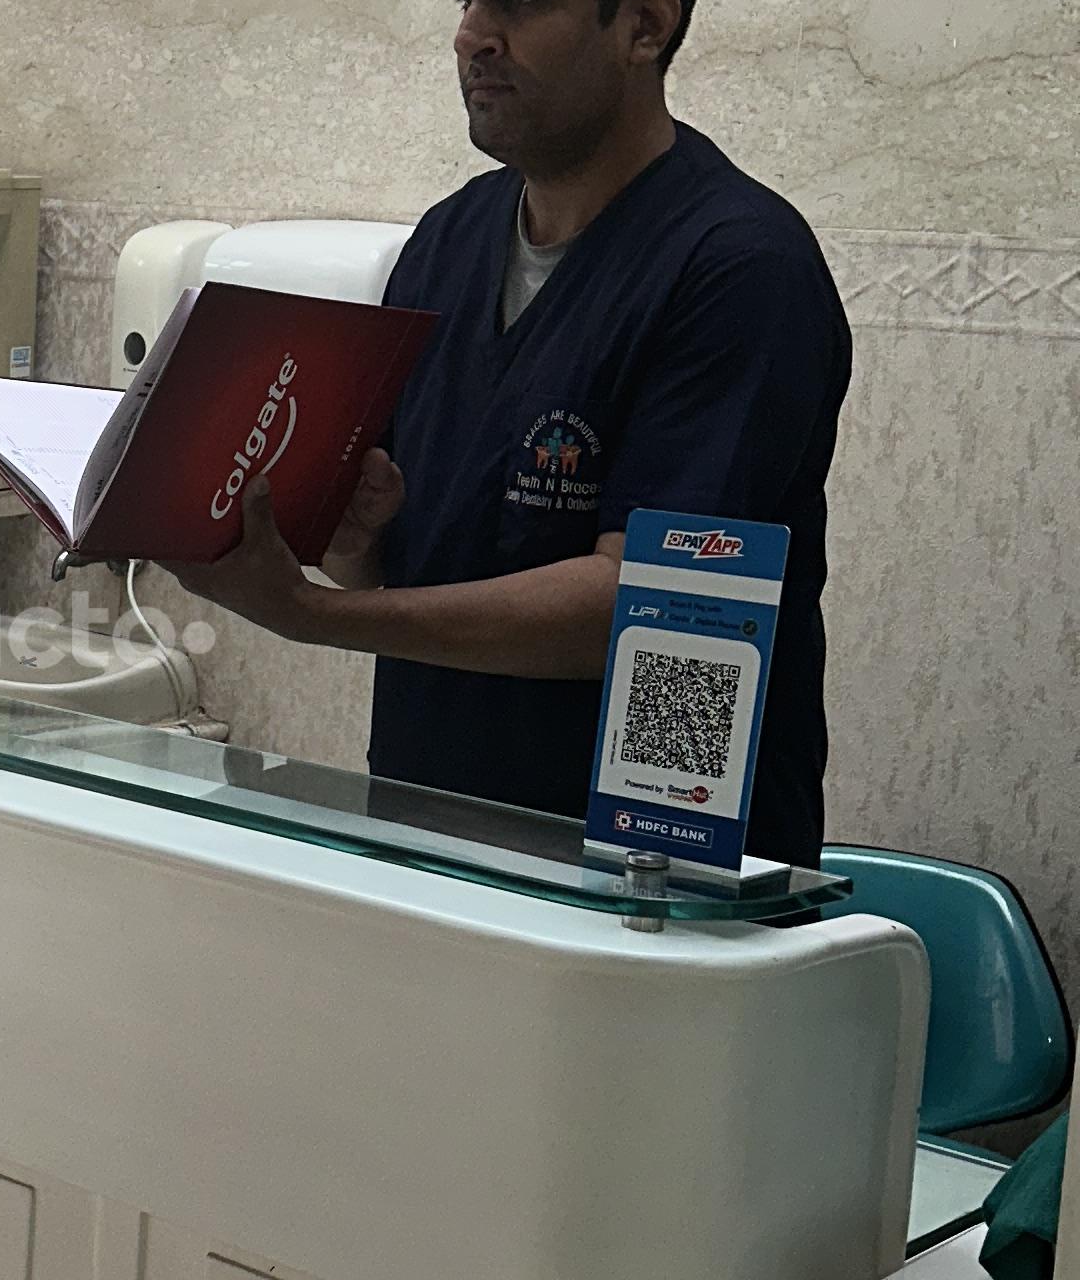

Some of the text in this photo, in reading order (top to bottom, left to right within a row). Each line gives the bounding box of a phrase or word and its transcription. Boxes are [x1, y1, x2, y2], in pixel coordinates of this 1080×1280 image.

[211, 357, 298, 520] Colgate
[523, 414, 548, 448] BRACES
[550, 409, 565, 421] ARE
[517, 472, 540, 489] Teeth
[546, 478, 555, 492] N
[555, 496, 563, 509] &
[629, 605, 660, 619] UPI
[624, 779, 655, 791] Powered
[655, 784, 664, 794] by
[636, 819, 707, 842] HDFC BANK
